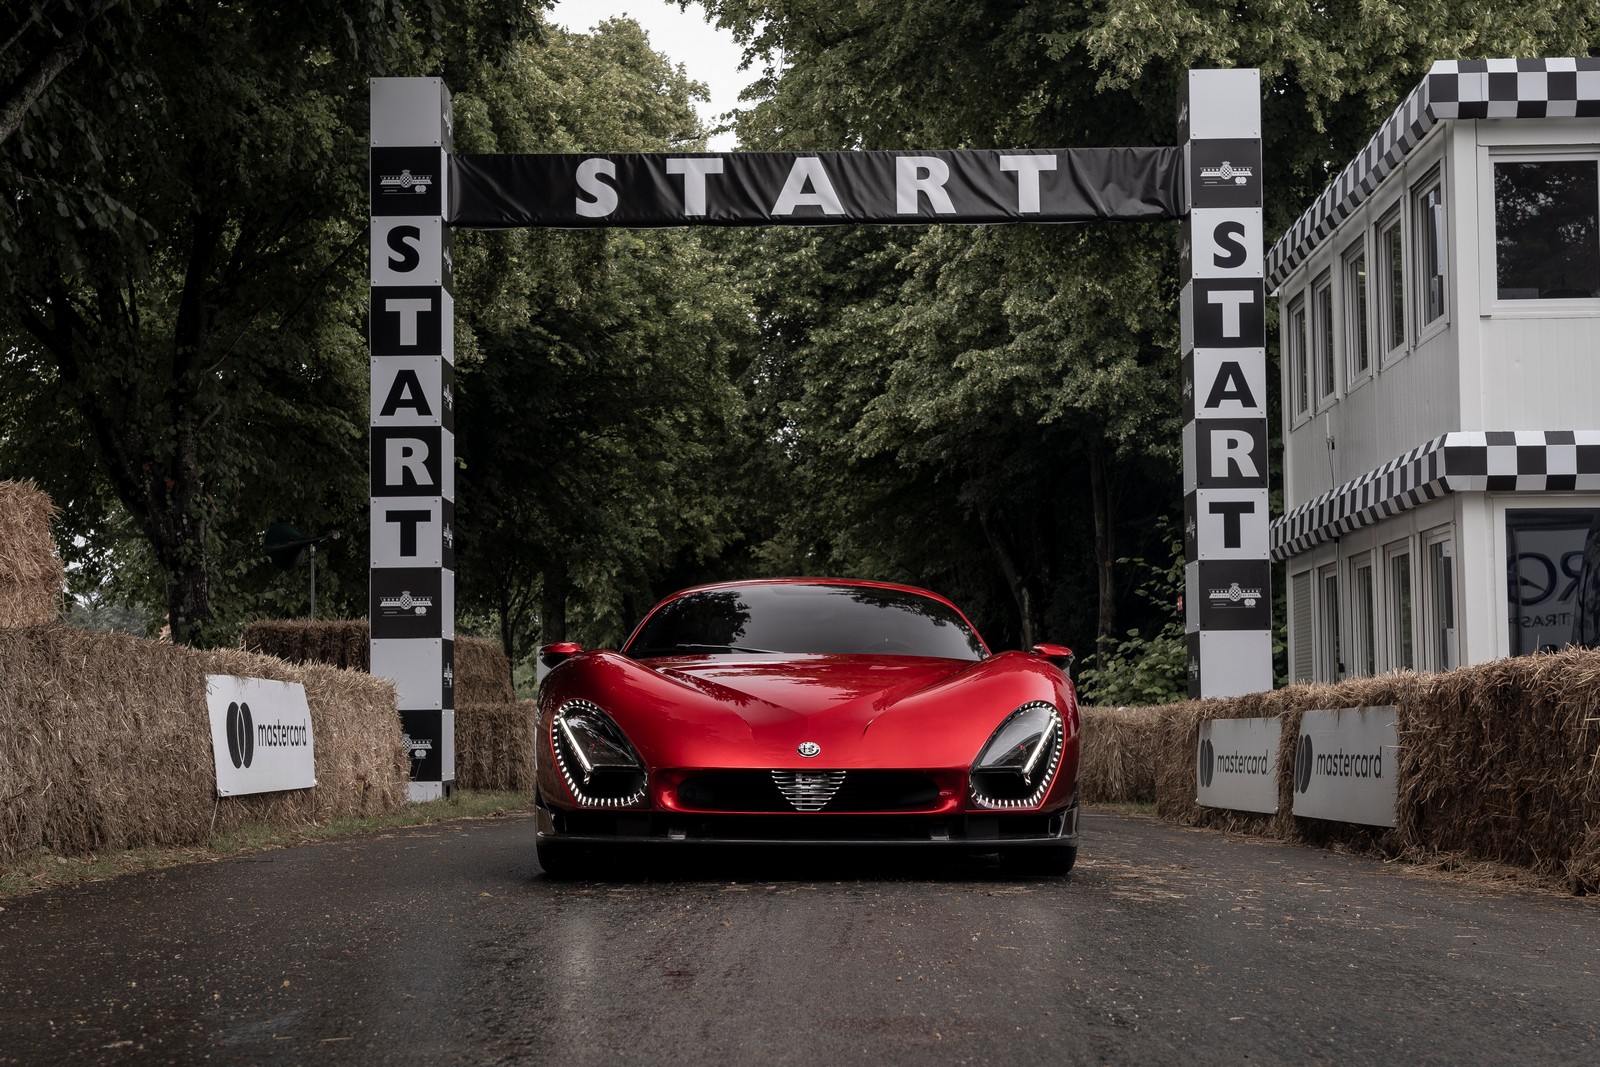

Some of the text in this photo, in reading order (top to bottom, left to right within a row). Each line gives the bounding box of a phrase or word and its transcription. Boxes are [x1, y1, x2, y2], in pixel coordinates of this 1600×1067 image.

[575, 154, 1058, 218] START
[379, 225, 434, 557] START
[1203, 220, 1260, 549] START
[257, 718, 308, 747] mastercard
[1216, 749, 1269, 776] mastercard
[1316, 745, 1383, 779] mastercard
